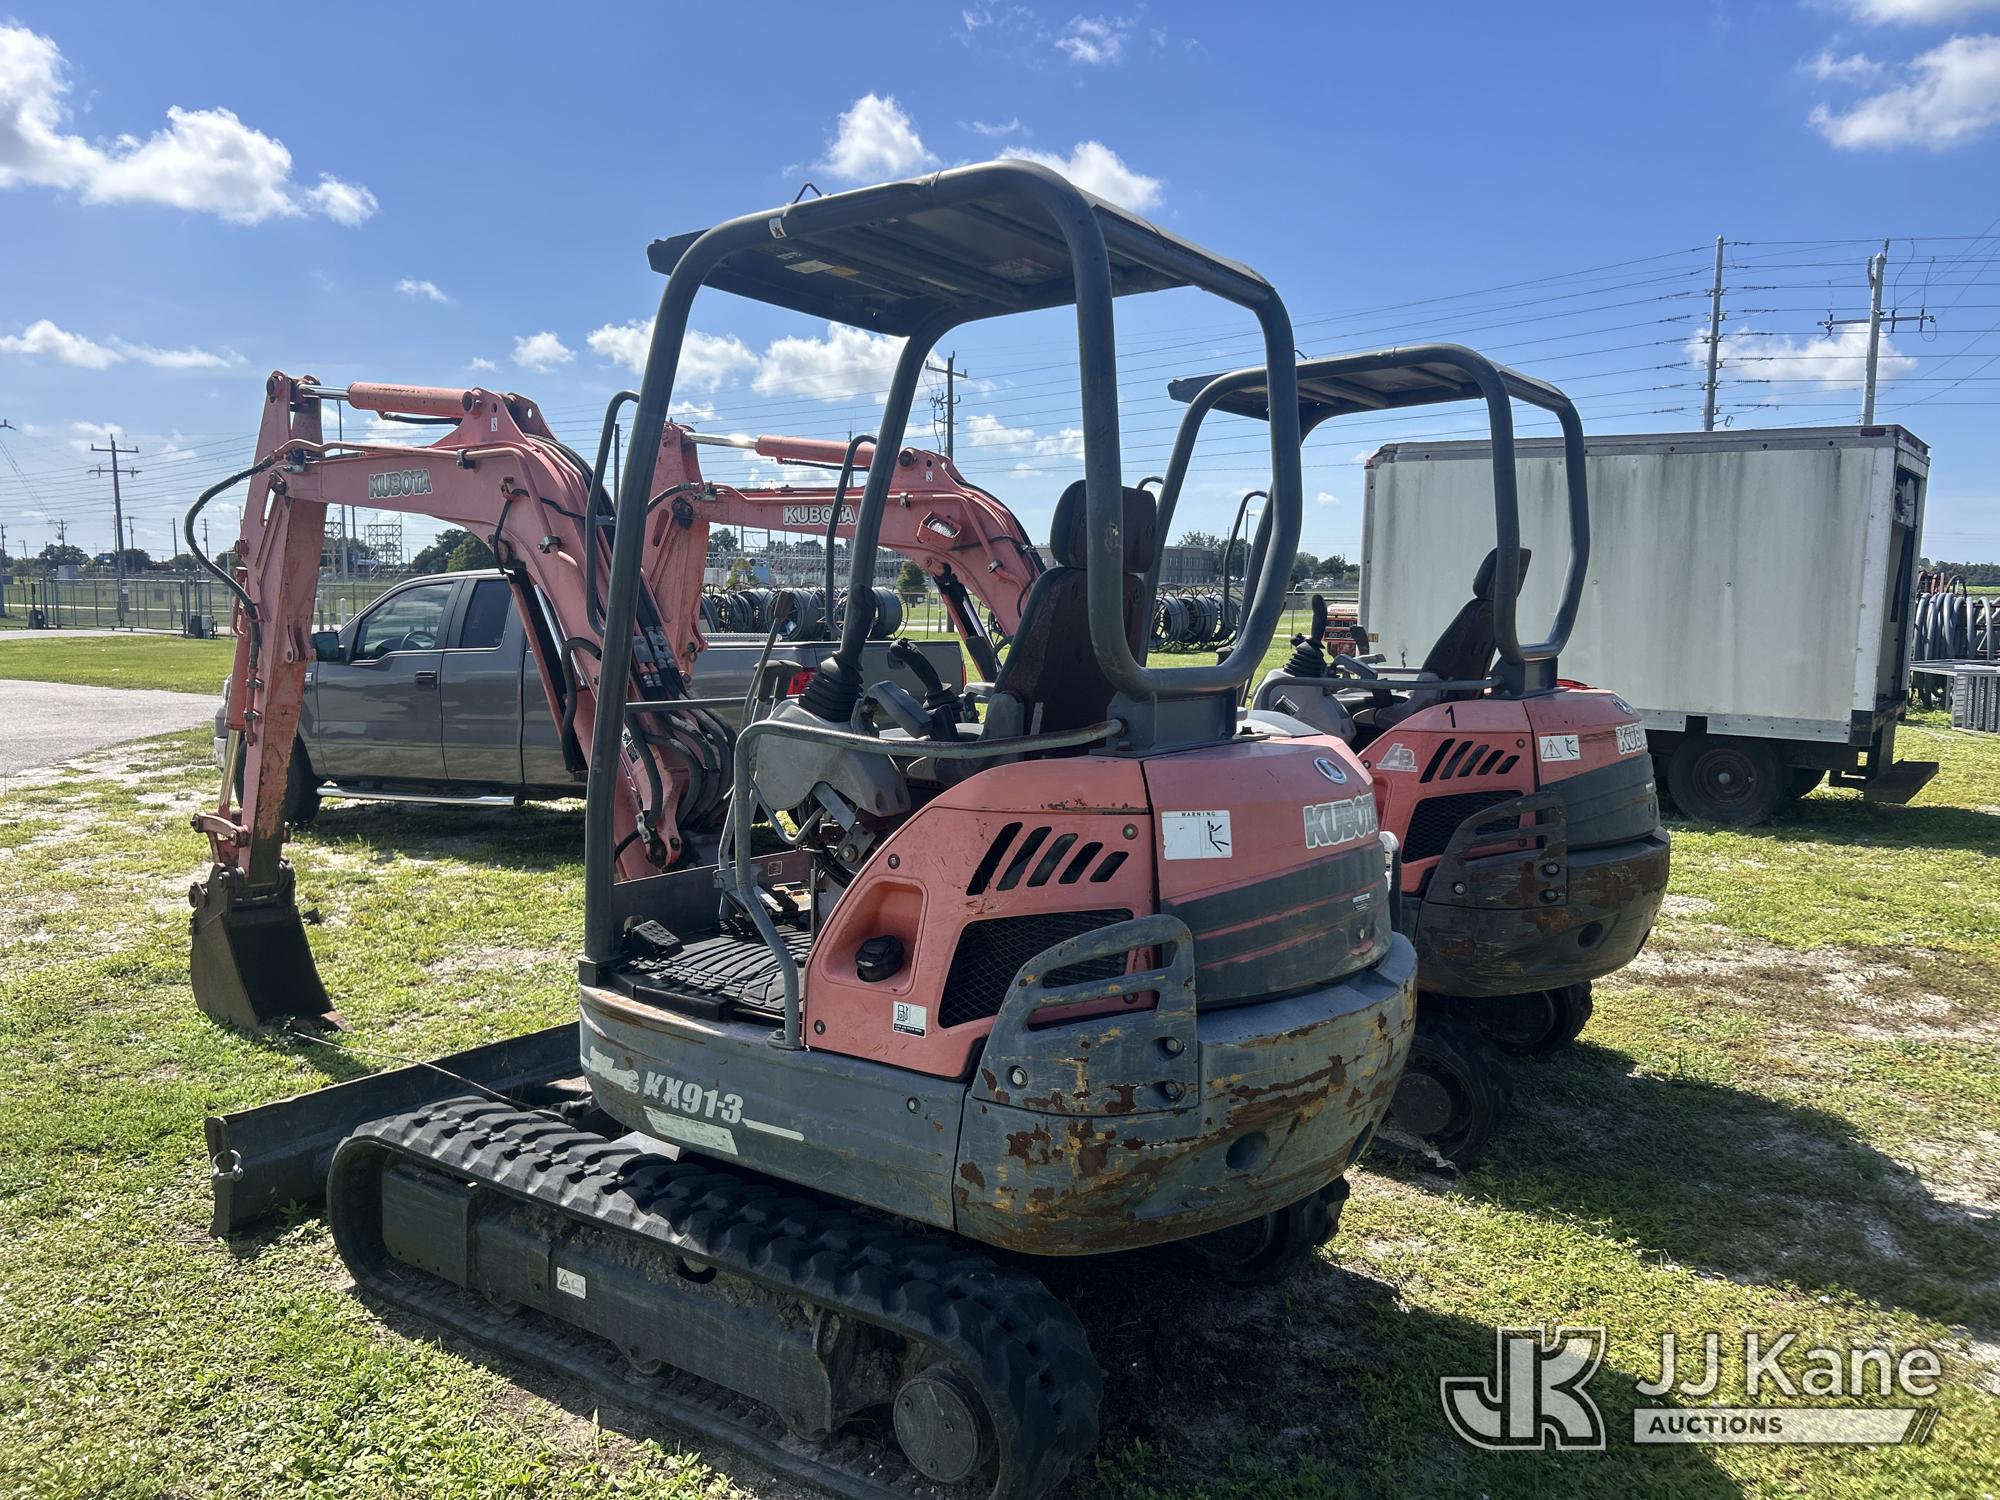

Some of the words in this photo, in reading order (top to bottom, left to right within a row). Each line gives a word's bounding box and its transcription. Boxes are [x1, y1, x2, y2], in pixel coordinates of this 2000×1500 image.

[369, 469, 432, 499] KUBOTA
[1445, 705, 1456, 728] 1
[1616, 722, 1648, 756] KUB
[643, 1071, 744, 1124] KX91-3
